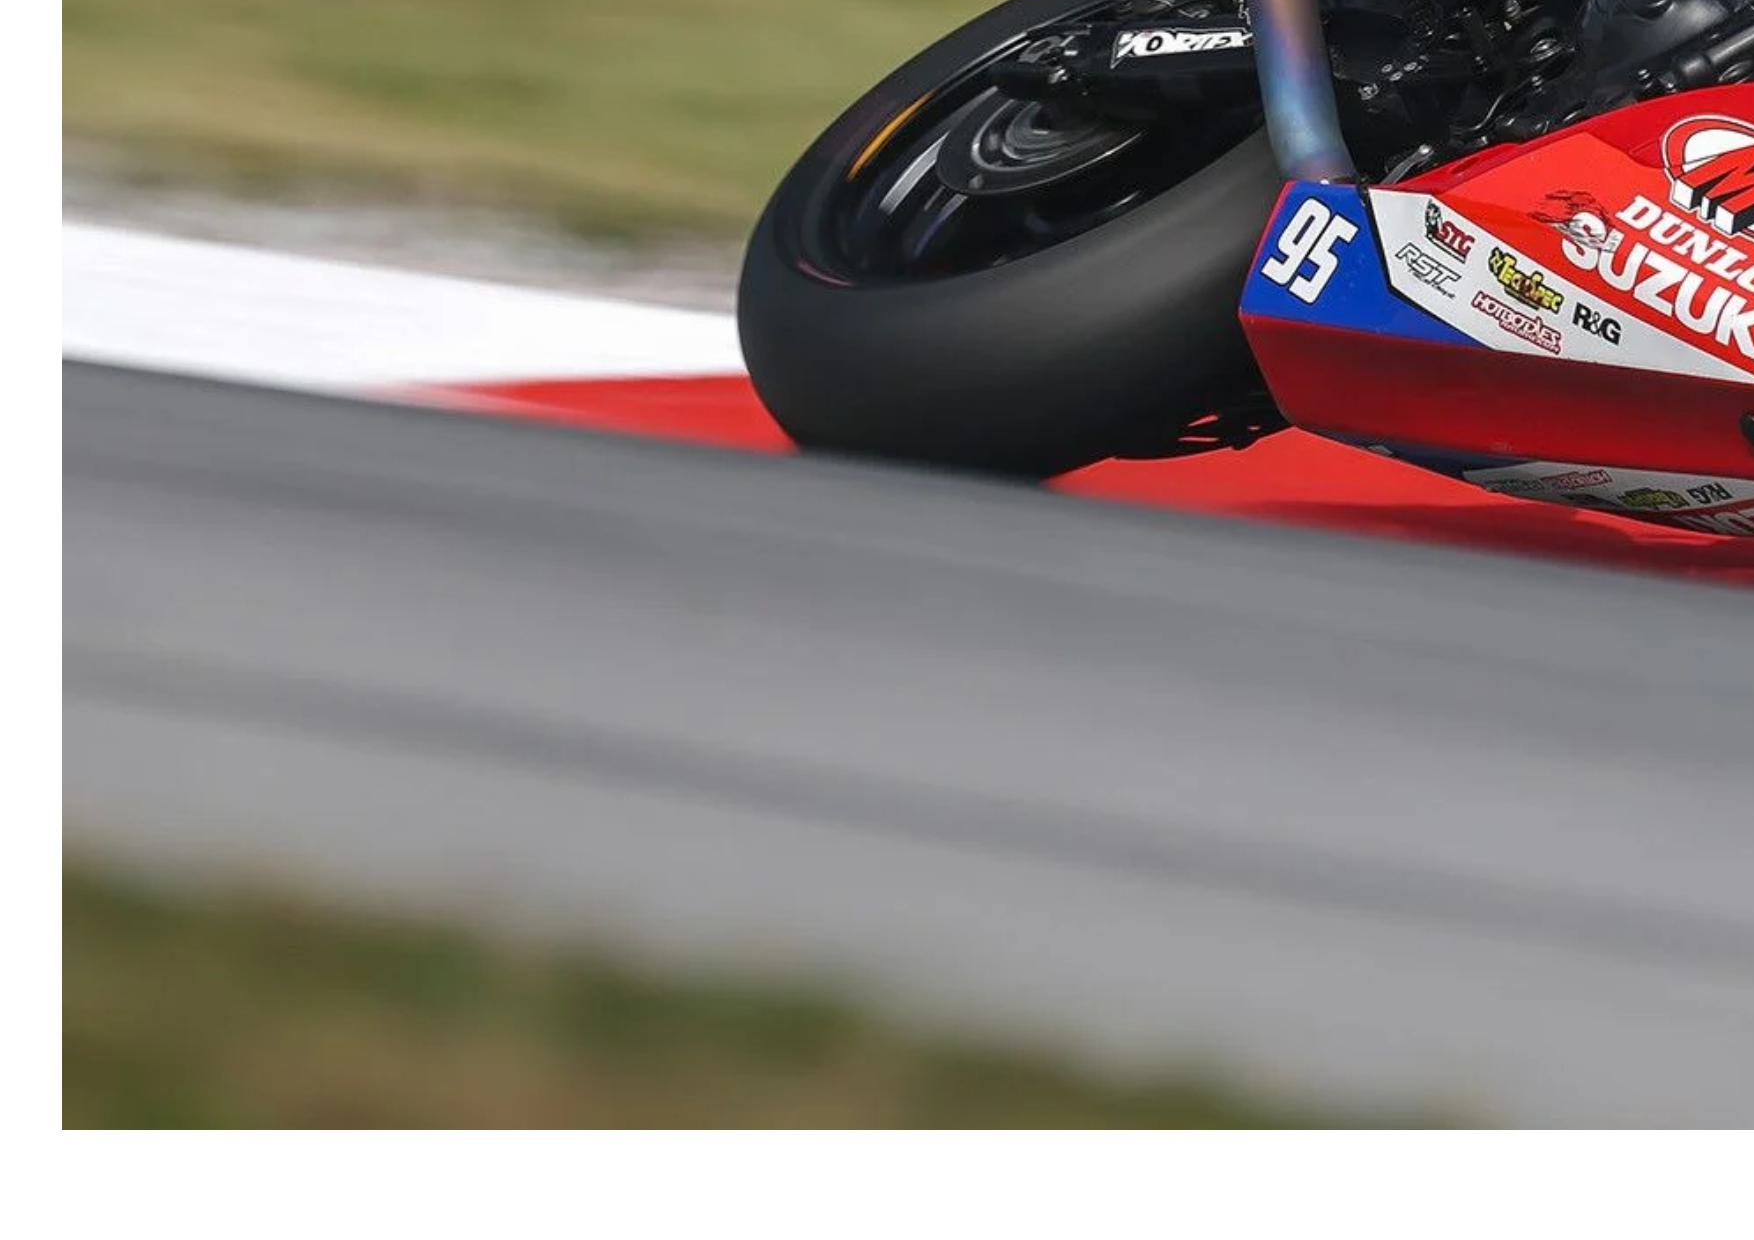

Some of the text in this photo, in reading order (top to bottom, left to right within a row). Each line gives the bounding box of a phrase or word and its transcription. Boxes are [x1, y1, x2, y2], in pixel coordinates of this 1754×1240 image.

[1116, 31, 1253, 58] VORTEX
[1261, 198, 1359, 303] 95
[1395, 242, 1462, 286] RST
[1572, 303, 1622, 345] R&G
